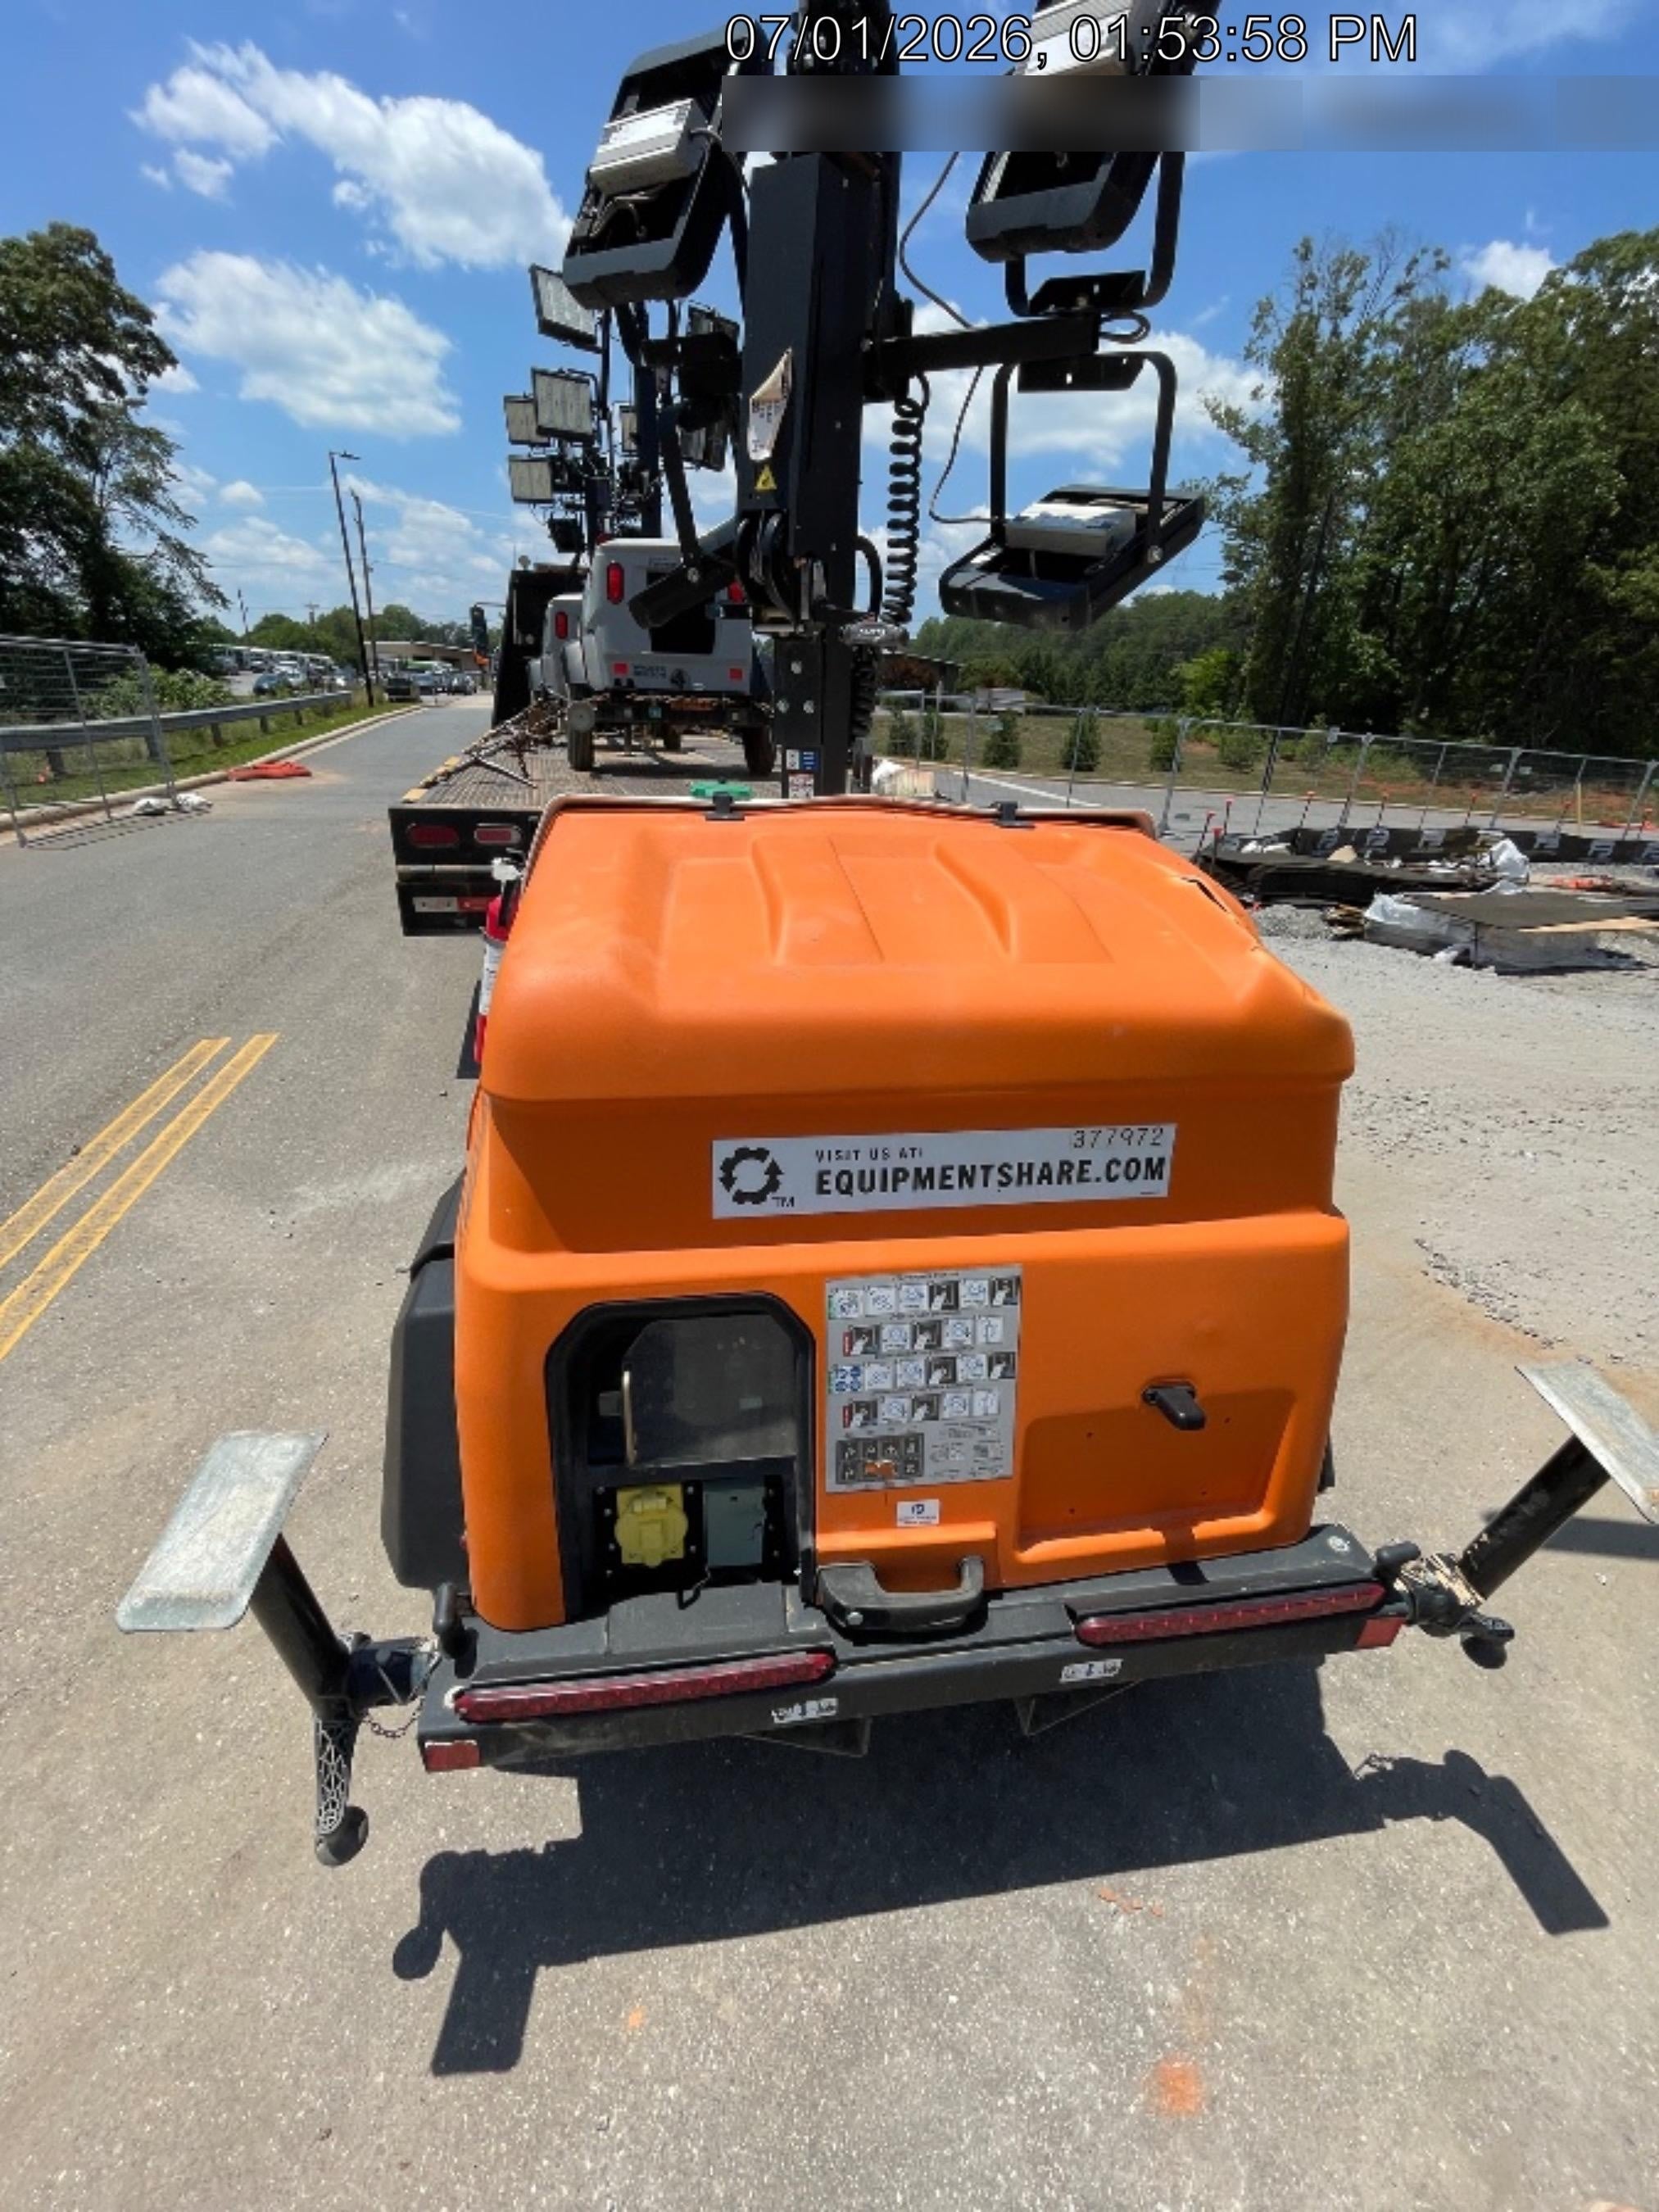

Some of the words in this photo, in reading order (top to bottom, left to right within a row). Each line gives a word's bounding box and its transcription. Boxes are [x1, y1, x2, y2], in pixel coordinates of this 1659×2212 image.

[1073, 1127, 1163, 1149] 377972
[815, 1149, 861, 1163] VISIT
[869, 1147, 891, 1161] US
[816, 1157, 1165, 1198] EQUIPMENTSHARE.COM
[771, 1196, 795, 1208] TM
